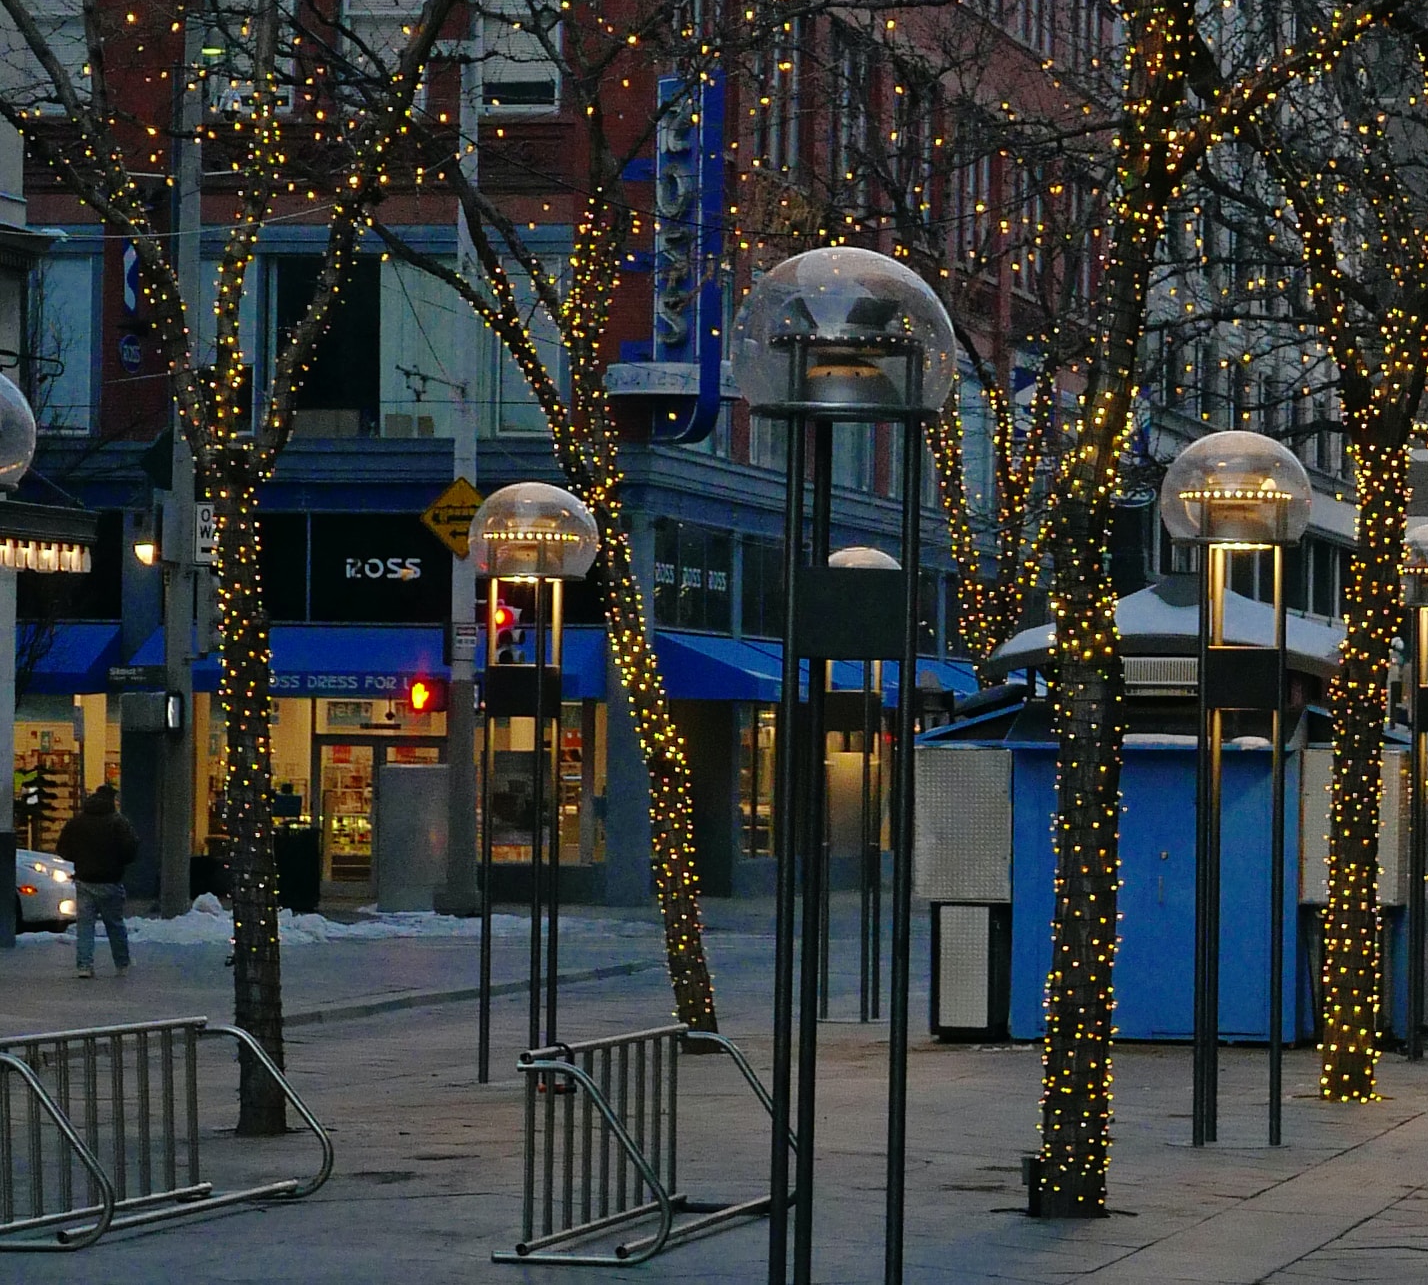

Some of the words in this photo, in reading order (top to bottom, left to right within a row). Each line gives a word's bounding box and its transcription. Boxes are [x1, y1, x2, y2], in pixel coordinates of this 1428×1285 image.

[346, 558, 421, 579] ROSS
[655, 562, 675, 584] ROSS
[682, 566, 701, 588] ROSS
[269, 676, 300, 689] OSS
[307, 676, 358, 689] DRESS
[365, 676, 397, 689] FOR
